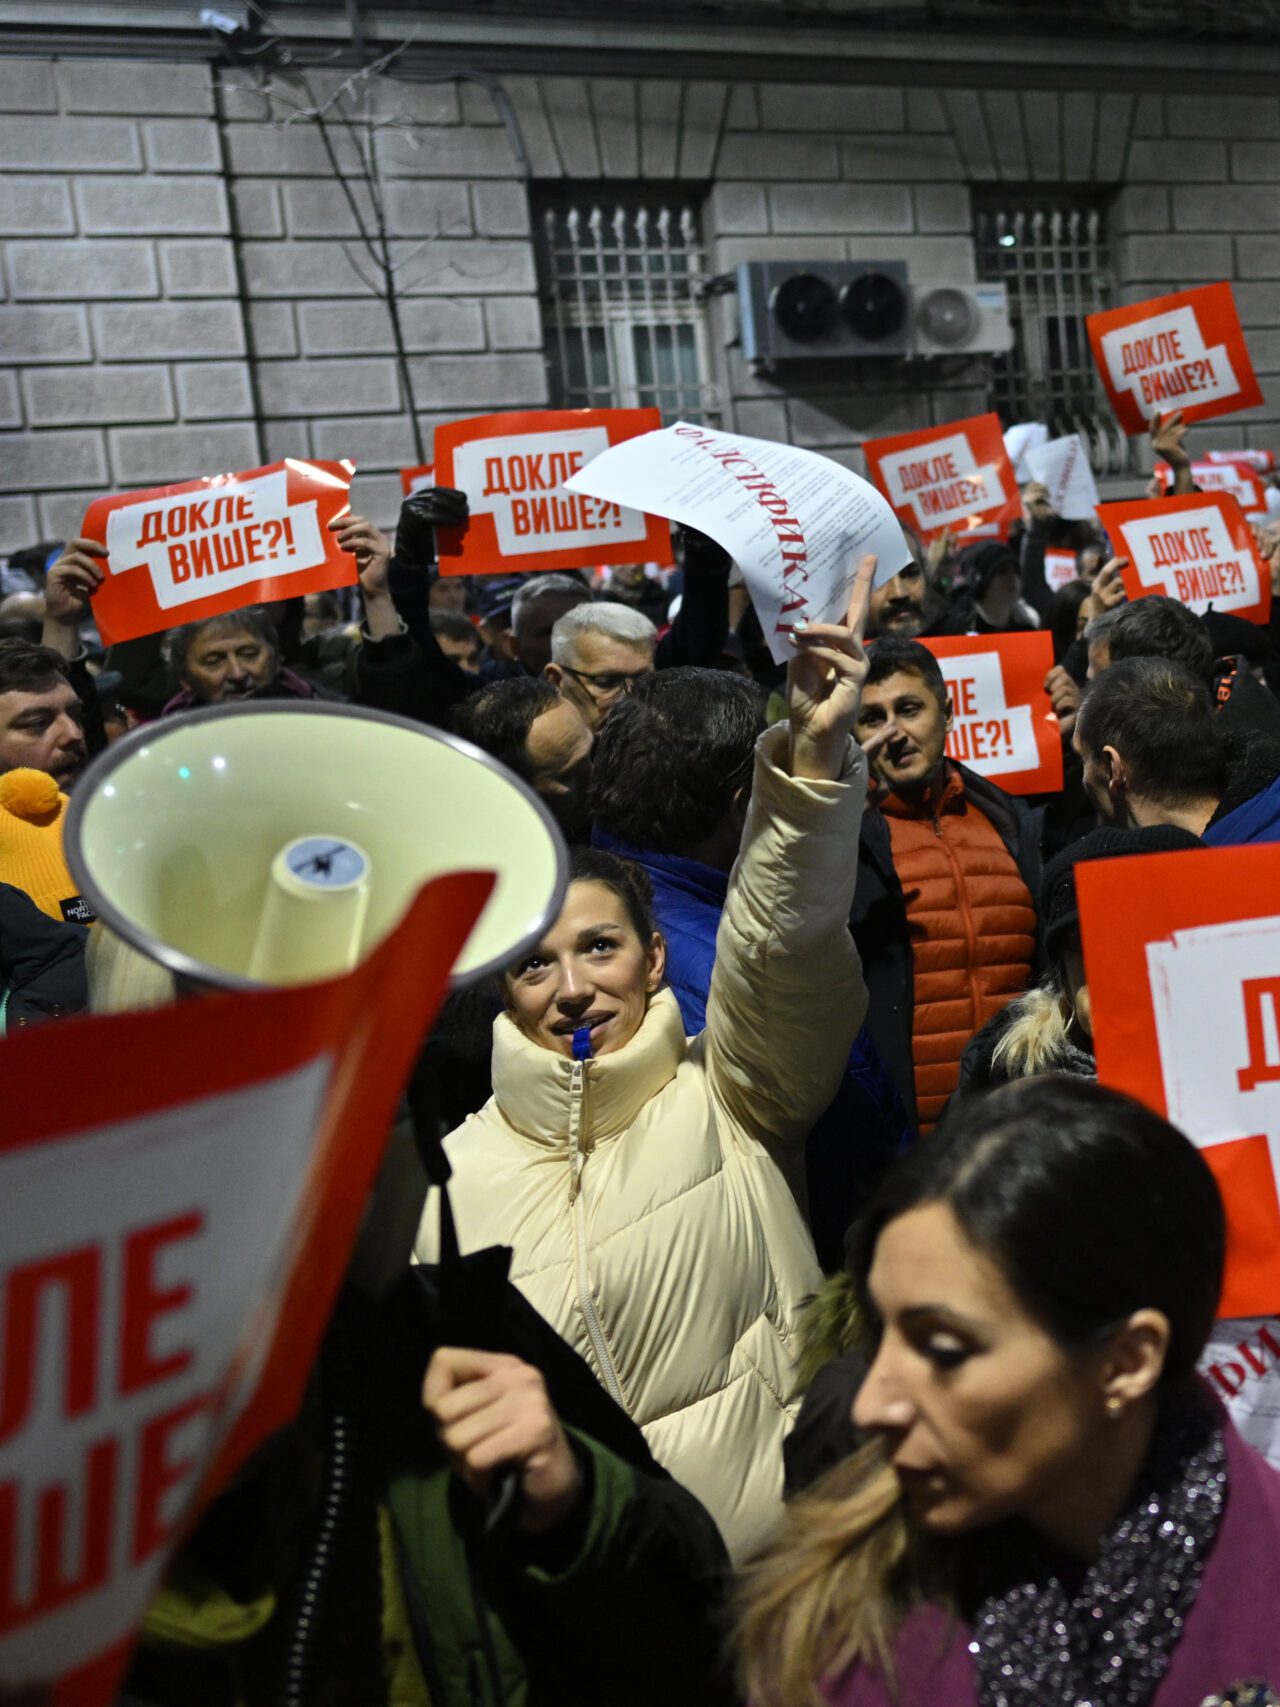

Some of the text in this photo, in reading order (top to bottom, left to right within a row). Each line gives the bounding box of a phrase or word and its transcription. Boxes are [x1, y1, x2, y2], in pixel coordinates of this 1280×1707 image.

[1121, 329, 1184, 378] ДОКЛЕ
[1139, 358, 1219, 405] ВИШЕ?!
[483, 451, 583, 497] ДОКЛЕ
[898, 453, 959, 493] ДОКЛЕ
[136, 491, 256, 549] ДОКЛЕ
[167, 516, 296, 585] ВИШЕ?!
[1148, 527, 1218, 569] ДОКЛЕ
[1173, 561, 1246, 602] ВИШЕ?!
